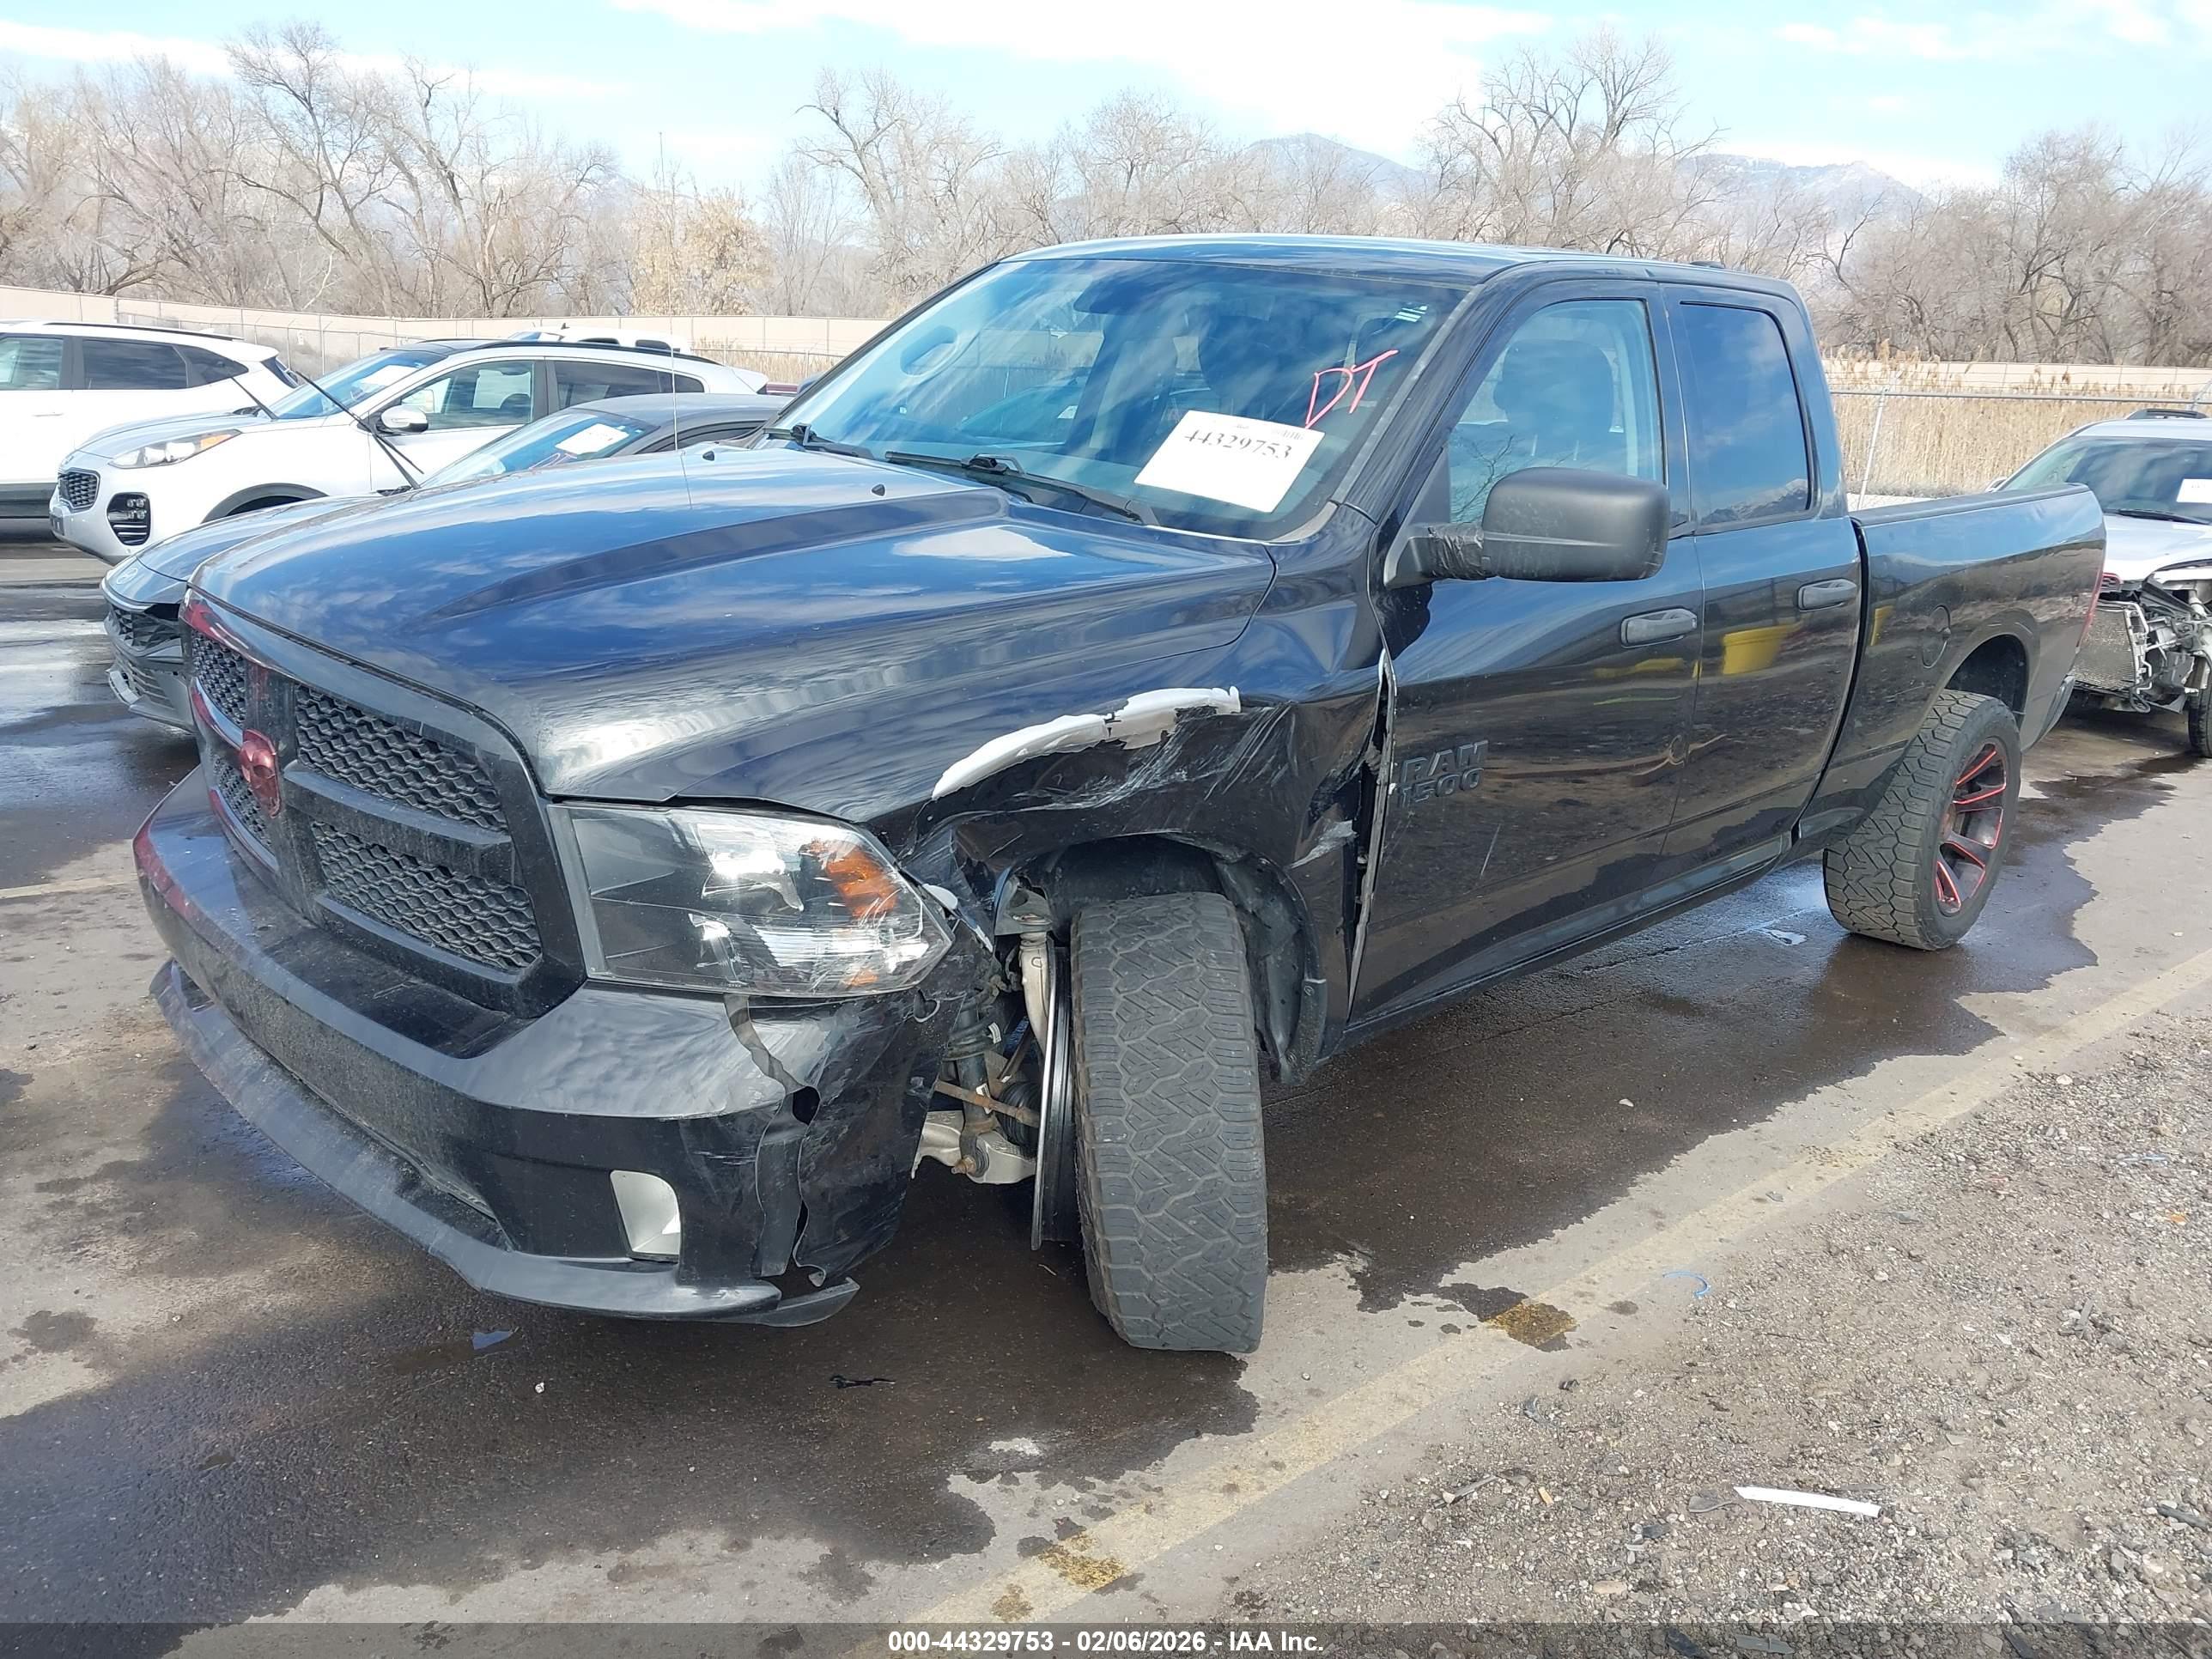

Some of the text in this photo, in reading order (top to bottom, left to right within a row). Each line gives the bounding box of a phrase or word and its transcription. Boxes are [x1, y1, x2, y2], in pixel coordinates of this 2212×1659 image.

[1304, 349, 1399, 429] DT
[1184, 428, 1293, 459] 44329753
[1401, 739, 1489, 785] RAM
[1400, 768, 1485, 808] 1500
